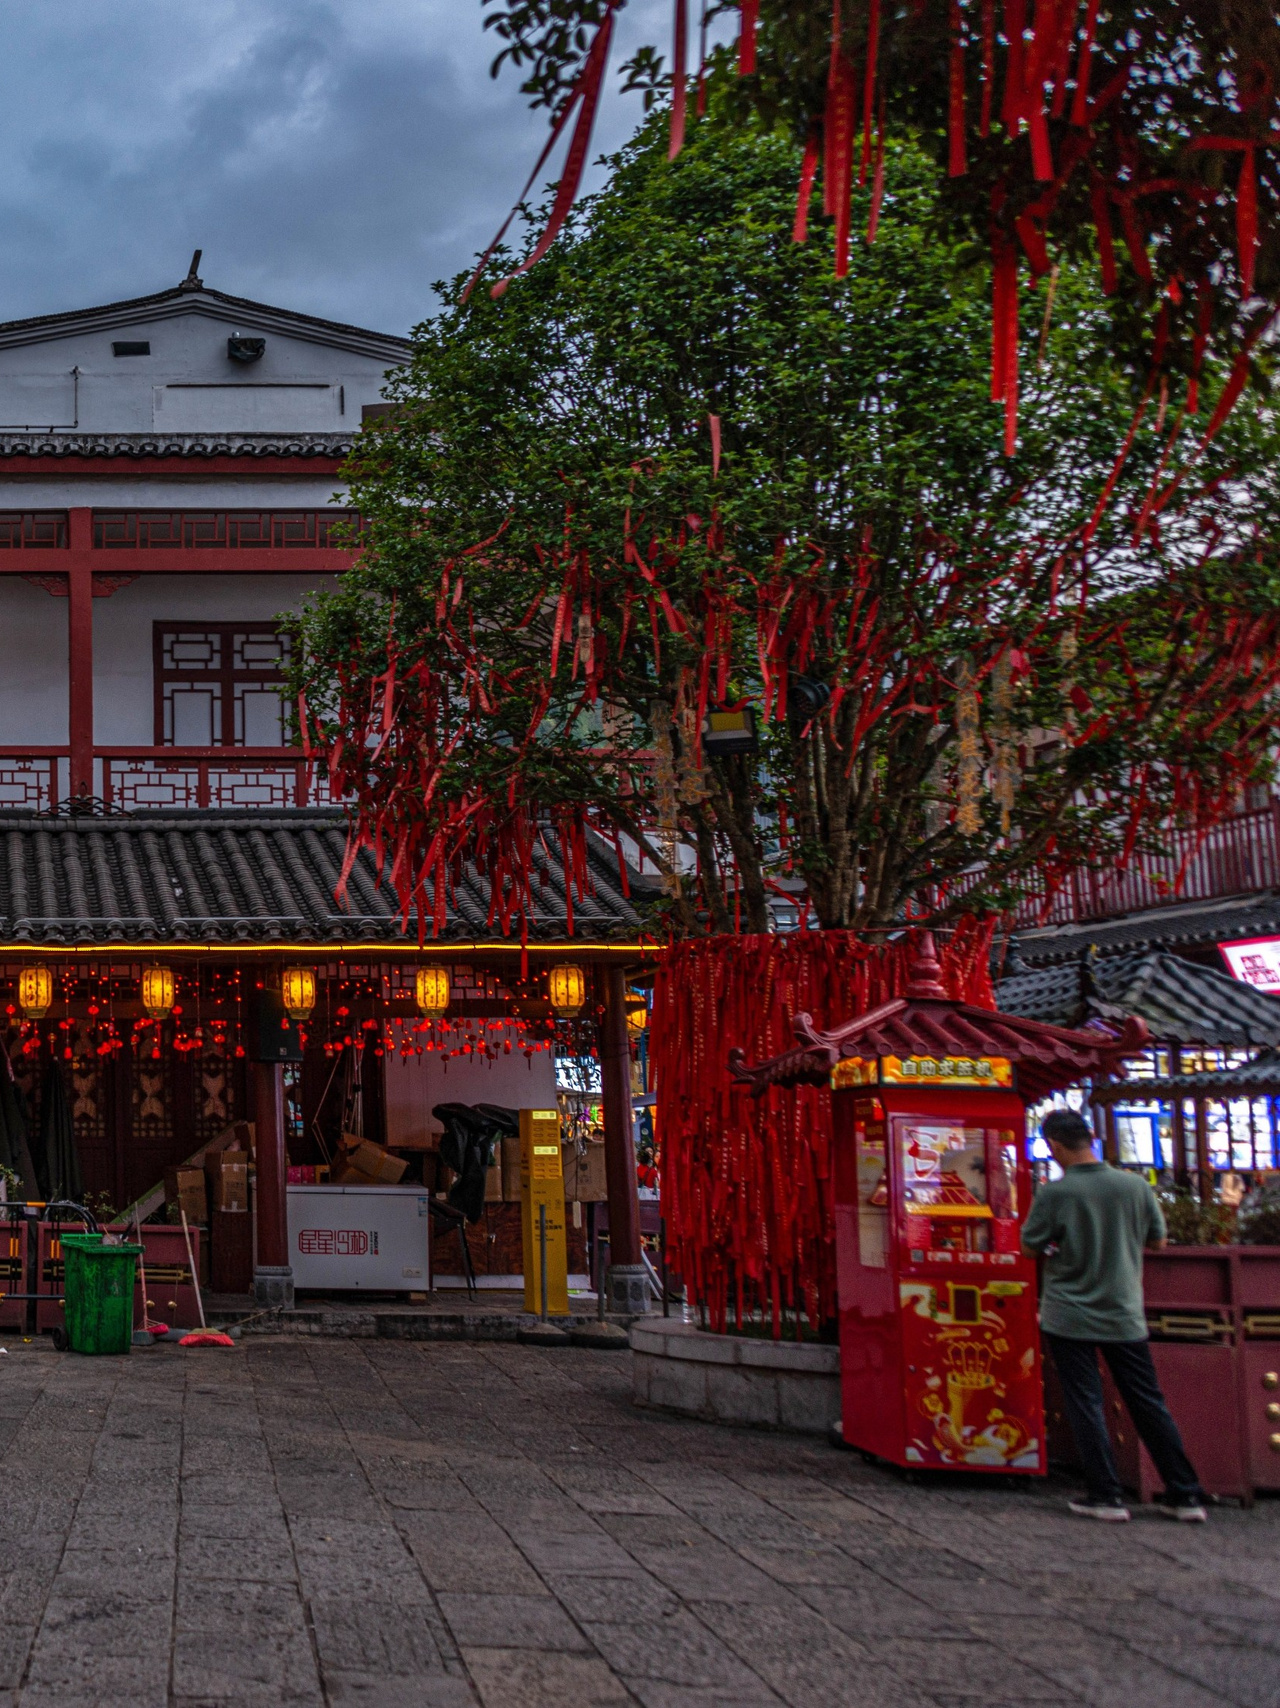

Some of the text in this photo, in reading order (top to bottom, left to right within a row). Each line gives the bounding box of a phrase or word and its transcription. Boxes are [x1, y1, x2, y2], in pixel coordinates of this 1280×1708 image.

[902, 1059, 993, 1077] 自助求签机
